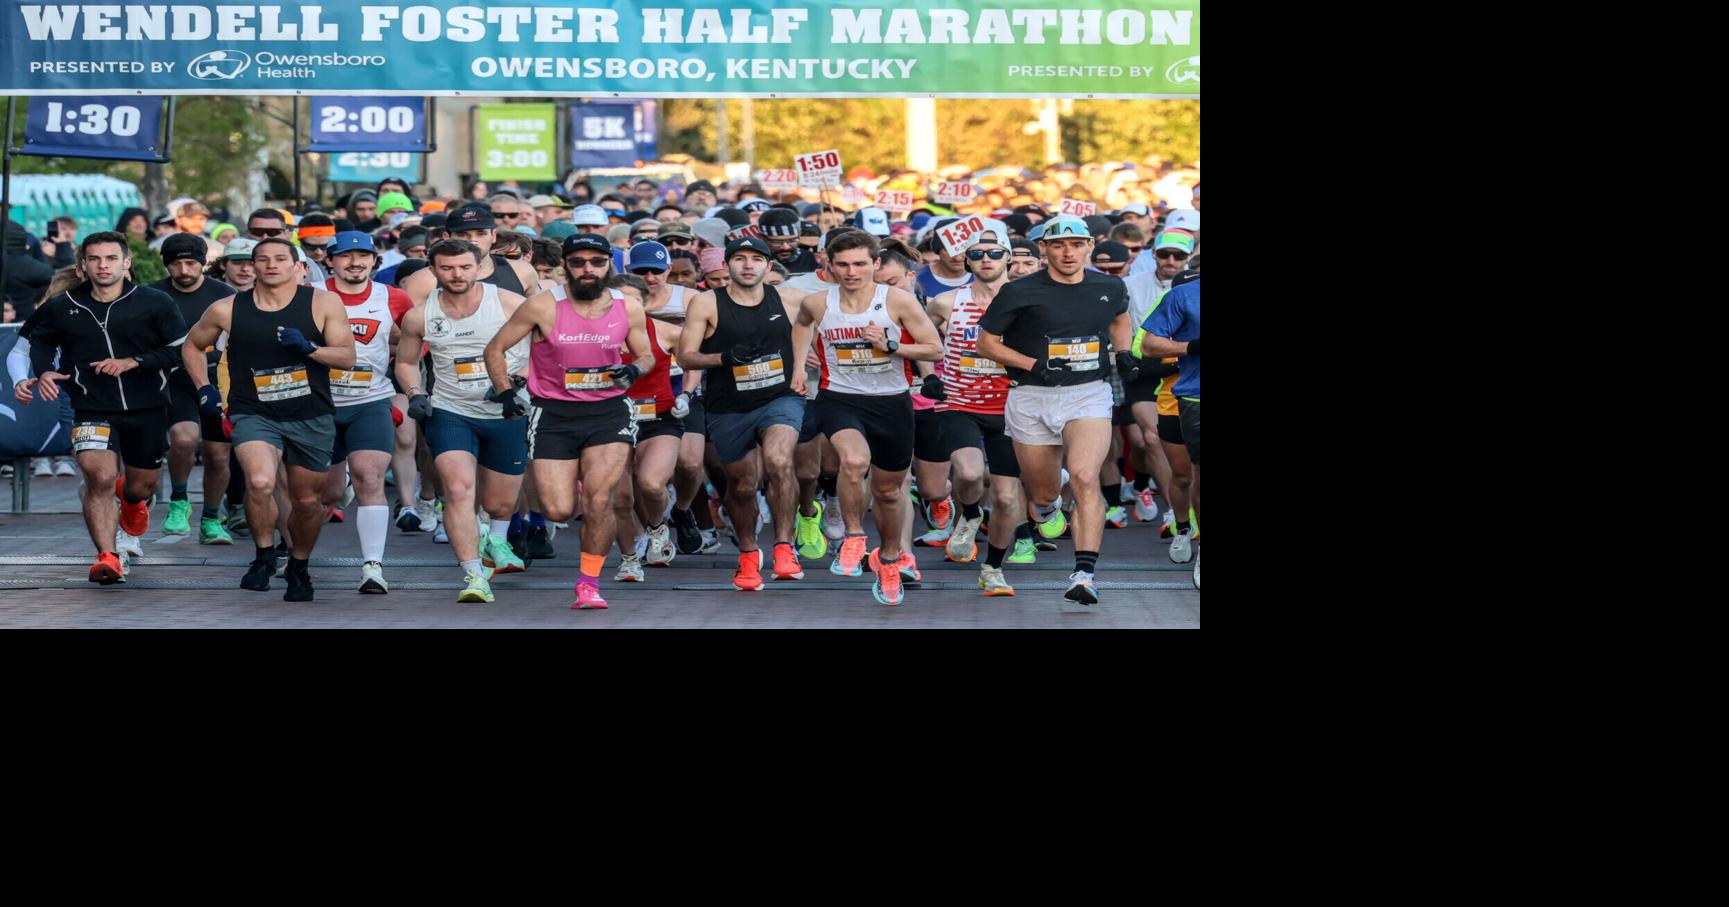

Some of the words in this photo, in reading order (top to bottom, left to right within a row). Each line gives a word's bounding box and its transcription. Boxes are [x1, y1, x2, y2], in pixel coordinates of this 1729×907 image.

[21, 5, 339, 41] WENDELL
[361, 5, 619, 43] FOSTER
[642, 8, 808, 44] HALF
[831, 8, 1193, 46] MARATHON
[255, 51, 386, 66] Owensboro
[30, 61, 145, 73] PRESENTED
[151, 61, 175, 73] BY
[257, 67, 316, 78] Health
[471, 56, 716, 82] OWENSBORO,
[726, 58, 918, 80] KENTUCKY
[1008, 65, 1122, 77] PRESENTED
[1130, 66, 1154, 77] BY
[45, 102, 141, 137] 1:30
[320, 105, 414, 133] 2:00
[487, 118, 546, 131] FINISH
[582, 116, 626, 138] 5K
[496, 133, 540, 144] TIME
[486, 149, 549, 168] 3:00
[797, 152, 839, 172] 1:50
[938, 182, 971, 197] 2:10
[877, 191, 910, 205] 2:15
[1062, 200, 1093, 217] 2:05
[941, 216, 985, 247] 1:30
[558, 333, 611, 344] KorfEdge
